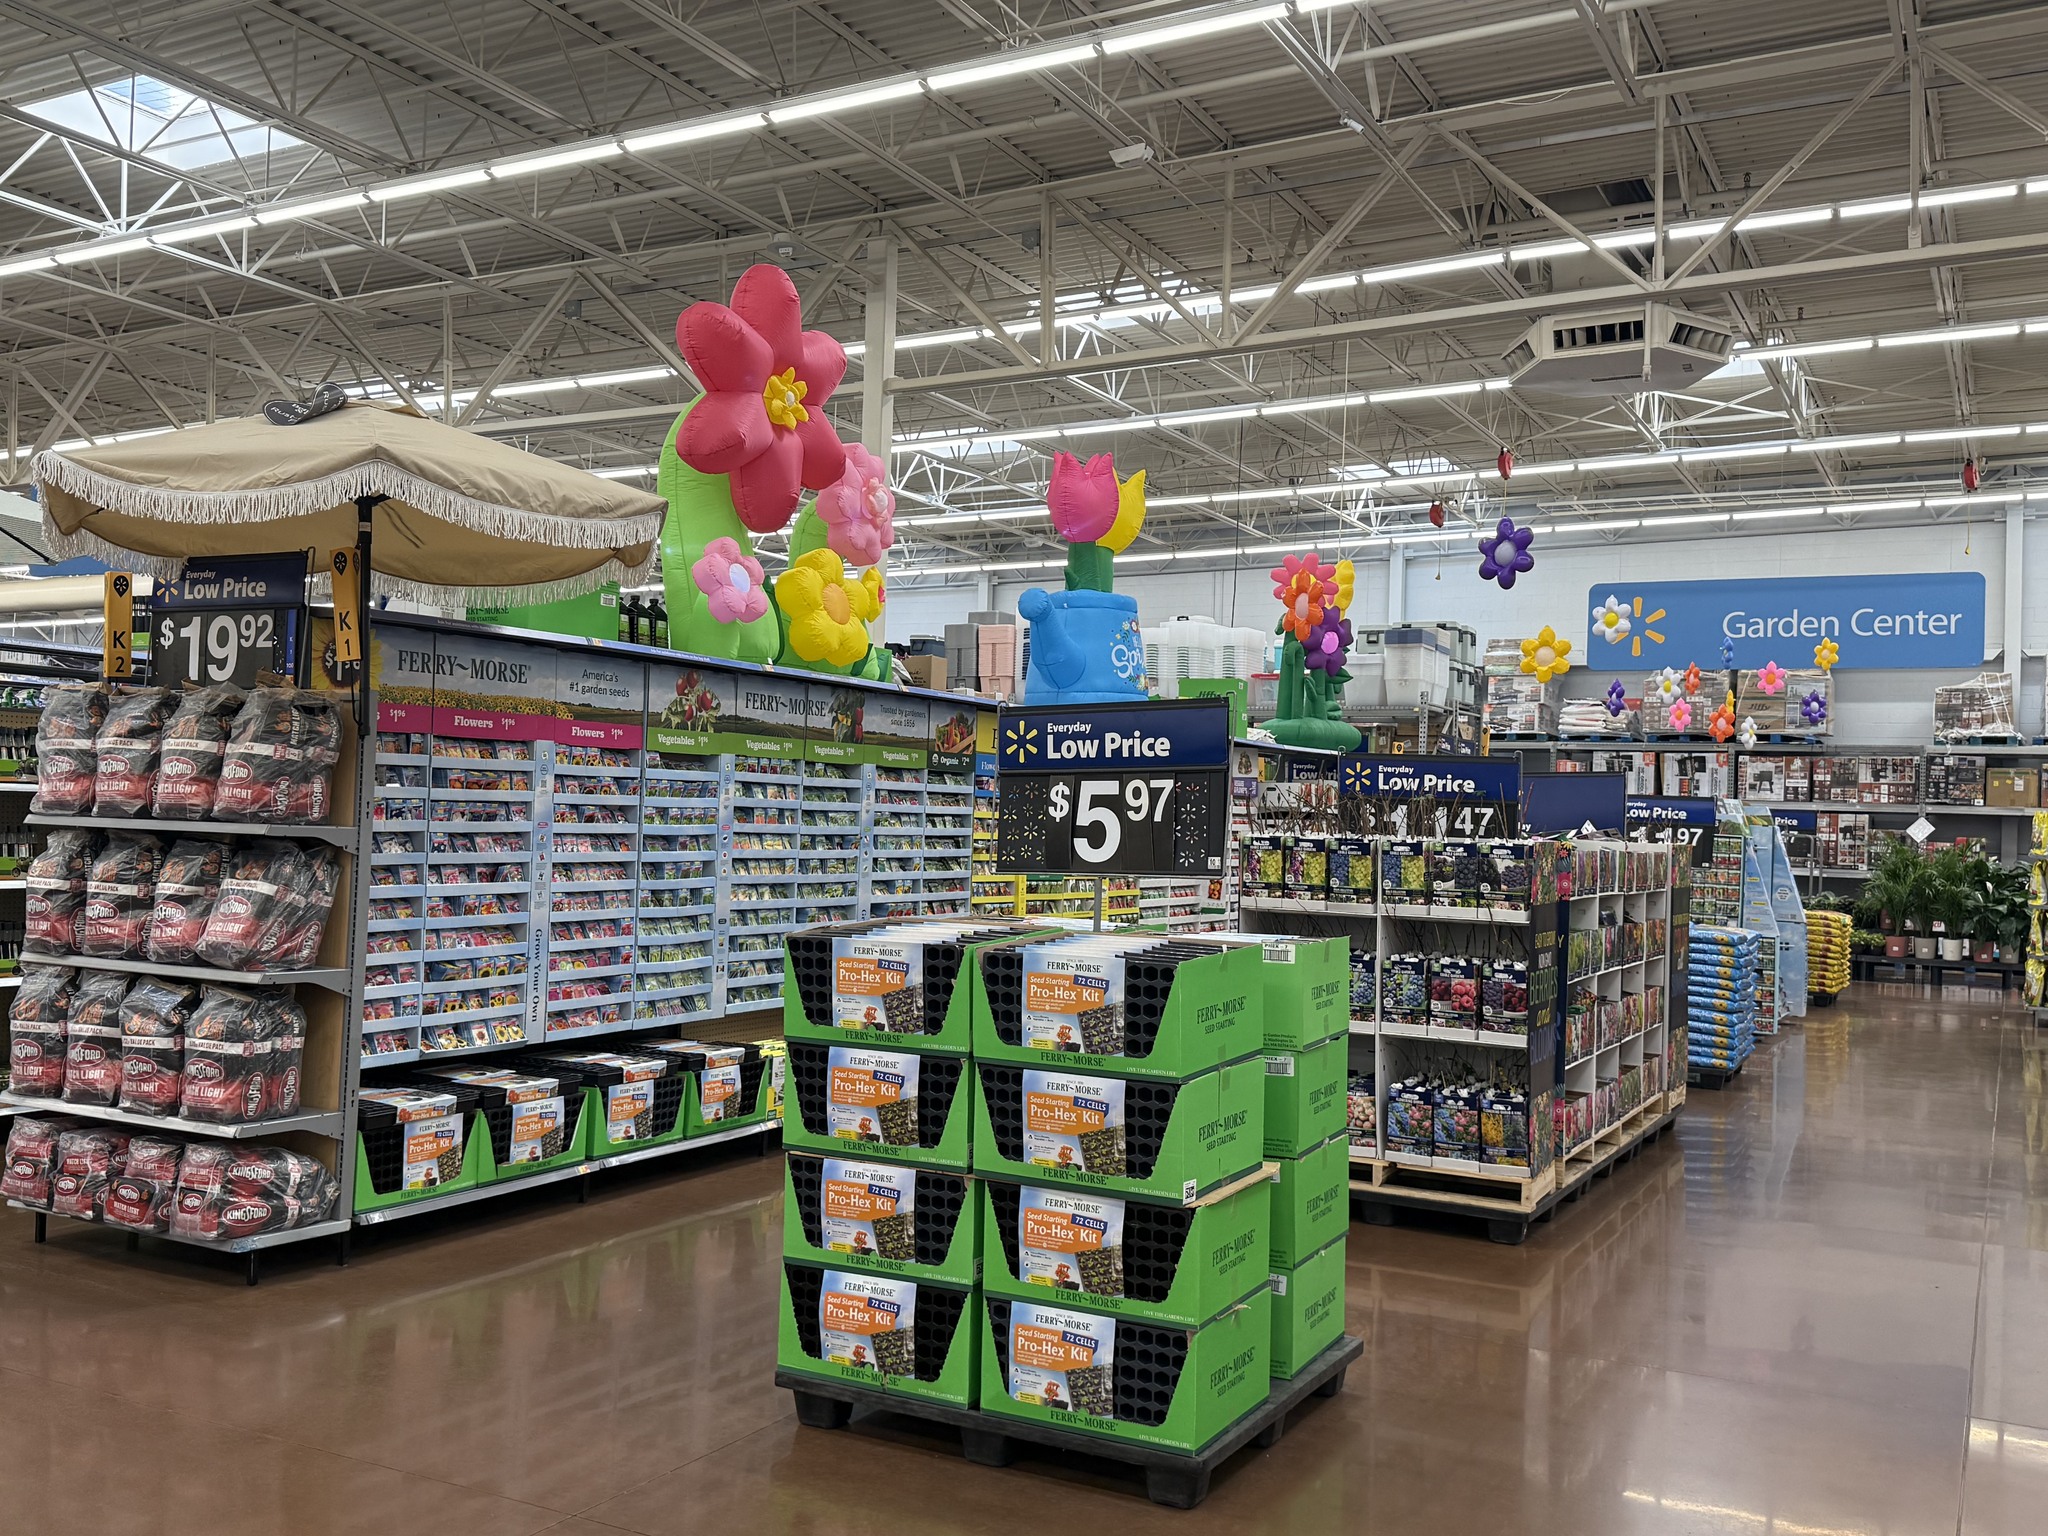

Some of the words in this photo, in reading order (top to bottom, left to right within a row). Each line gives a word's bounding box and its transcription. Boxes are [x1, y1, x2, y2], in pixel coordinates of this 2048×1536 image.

[186, 570, 216, 580] Everyday
[184, 581, 221, 600] Low
[223, 576, 267, 598] Price
[338, 612, 352, 631] K
[1723, 609, 1839, 638] Garden
[1851, 608, 1962, 636] Center
[113, 630, 126, 649] K
[344, 638, 351, 656] 1
[115, 656, 125, 673] 2
[582, 669, 619, 683] America's
[569, 682, 579, 692] #1
[581, 683, 607, 696] garden
[609, 685, 630, 698] seeds
[880, 705, 897, 714] Trusted
[898, 709, 904, 717] by
[904, 710, 926, 718] gardeners
[454, 715, 493, 729] Flowers
[891, 718, 902, 727] since
[1047, 722, 1092, 735] Everyday
[571, 726, 605, 739] Flowers
[657, 733, 695, 747] Vegetables
[746, 739, 780, 752] Vegetables
[1047, 735, 1100, 760] Low
[1105, 730, 1171, 758] Price
[814, 745, 844, 757] Vegetables
[882, 750, 909, 762] Vegetables
[940, 755, 959, 767] Organic
[1378, 765, 1414, 774] Everyday
[1378, 773, 1420, 790] Low
[1424, 774, 1475, 793] Price
[313, 778, 322, 817] KINGSFORD
[1653, 807, 1687, 819] Price
[1775, 817, 1798, 825] Price
[839, 960, 852, 969] Seed
[853, 963, 875, 971] Starting
[881, 961, 889, 969] 72
[889, 962, 907, 971] CELLS
[532, 964, 542, 993] Your
[839, 969, 881, 983] Pro-Hex
[885, 972, 901, 984] Kit
[1029, 976, 1043, 985] Seed
[1044, 978, 1070, 988] Starting
[1077, 977, 1085, 985] 72
[1086, 978, 1106, 988] CELLS
[1030, 985, 1077, 1000] Pro-Hex
[1082, 988, 1099, 1002] Kit
[1215, 1017, 1236, 1033] STARTING
[80, 1069, 106, 1079] LIGHT
[833, 1071, 847, 1080] Seed
[847, 1073, 870, 1082] Starting
[876, 1072, 883, 1080] 72
[884, 1074, 903, 1084] CELLS
[200, 1088, 225, 1098] LIGHT
[833, 1078, 876, 1094] Pro-Hex
[880, 1083, 896, 1097] Kit
[247, 1076, 261, 1116] KINGSFORD
[1030, 1095, 1043, 1105] Seed
[1044, 1097, 1070, 1108] Starting
[1078, 1098, 1085, 1107] 72
[1087, 1100, 1106, 1111] CELLS
[1030, 1104, 1077, 1120] Pro-Hex
[1082, 1109, 1099, 1125] Kit
[543, 1119, 553, 1128] Kit
[439, 1139, 450, 1148] Kit
[1206, 1140, 1217, 1152] SEED
[1217, 1133, 1237, 1149] STARTING
[233, 1167, 271, 1180] KINGSFORD
[871, 1186, 879, 1194] 72
[880, 1188, 899, 1199] CELLS
[828, 1191, 871, 1208] Pro-Hex
[876, 1196, 892, 1211] Kit
[227, 1206, 267, 1221] KINGSFORD
[1027, 1211, 1041, 1221] Seed
[1041, 1214, 1068, 1225] Starting
[1075, 1216, 1083, 1225] 72
[1084, 1218, 1105, 1230] CELLS
[1027, 1221, 1075, 1239] Pro-Hex
[1079, 1227, 1097, 1244] Kit
[1219, 1264, 1229, 1276] SEED
[1228, 1252, 1246, 1271] STARTING
[871, 1298, 879, 1307] 72
[879, 1300, 898, 1312] CELLS
[826, 1304, 871, 1321] Pro-Hex
[875, 1309, 892, 1325] Kit
[1017, 1327, 1032, 1338] Seed
[1032, 1330, 1059, 1342] Starting
[1066, 1332, 1074, 1341] 72
[1075, 1334, 1096, 1347] CELLS
[1017, 1336, 1066, 1357] Pro-Hex
[1070, 1345, 1088, 1361] Kit
[1217, 1386, 1227, 1398] SEED
[1227, 1371, 1245, 1392] STARTING
